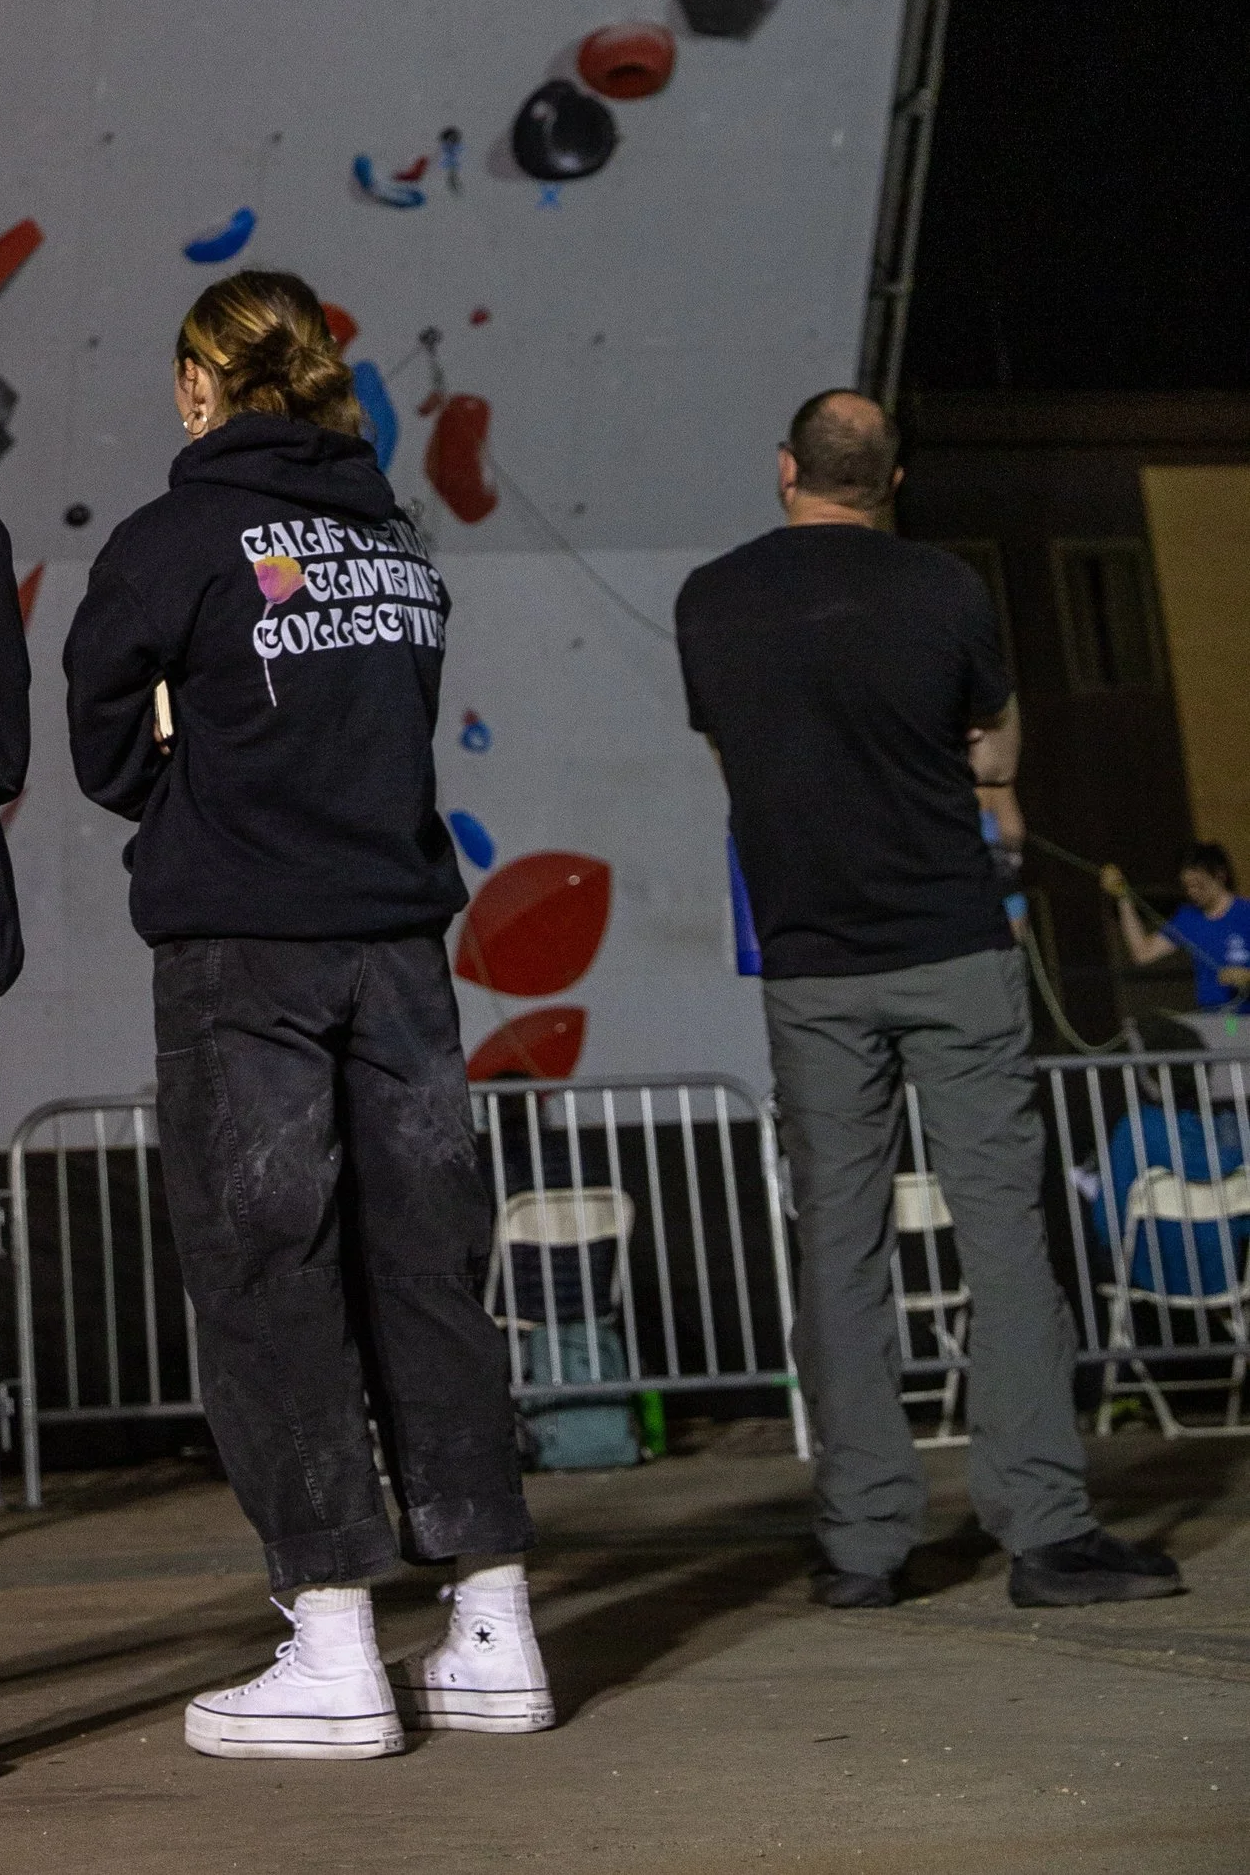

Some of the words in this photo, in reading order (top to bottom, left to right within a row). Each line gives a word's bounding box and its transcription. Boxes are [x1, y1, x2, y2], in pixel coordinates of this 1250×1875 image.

[241, 517, 428, 563] CALIFORNI
[304, 558, 441, 607] CLIMBING
[253, 603, 446, 659] COLLECTIVE
